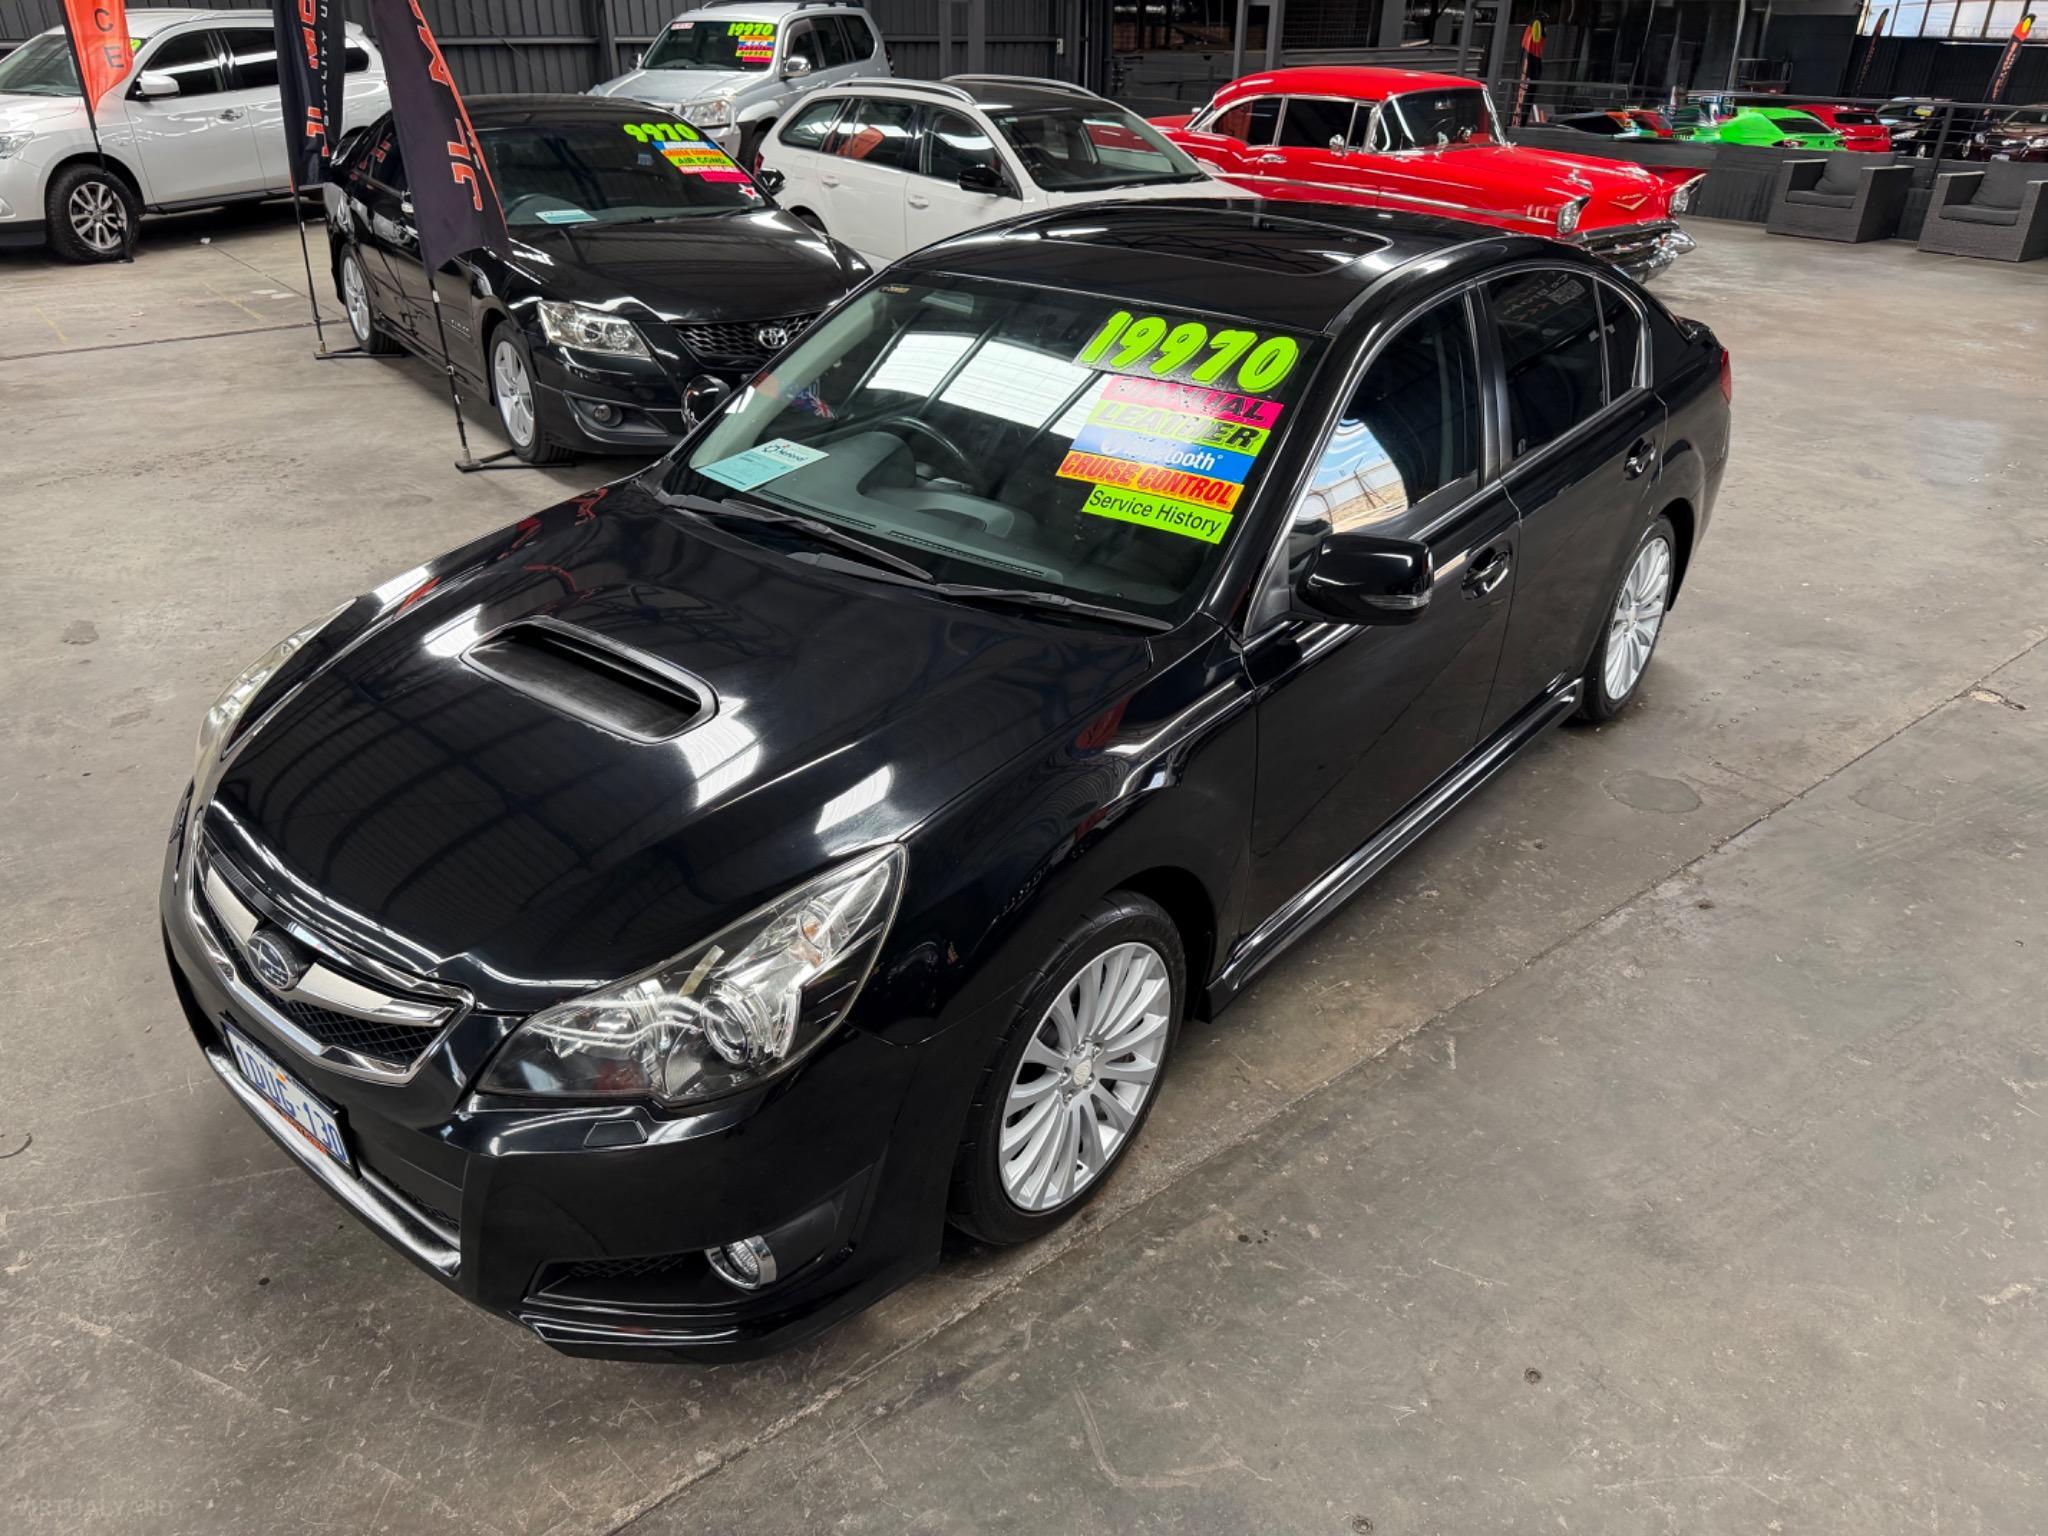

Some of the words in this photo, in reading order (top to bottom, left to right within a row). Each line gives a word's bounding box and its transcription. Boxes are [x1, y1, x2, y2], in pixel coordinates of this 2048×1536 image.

[727, 23, 774, 36] 19970
[623, 123, 700, 143] 9970
[1079, 311, 1298, 393] 19970
[1096, 402, 1262, 448] LEATHER
[1060, 453, 1136, 482] CRUISE
[1137, 466, 1235, 506] CONTROL
[1089, 490, 1153, 517] Service
[1156, 503, 1223, 536] History
